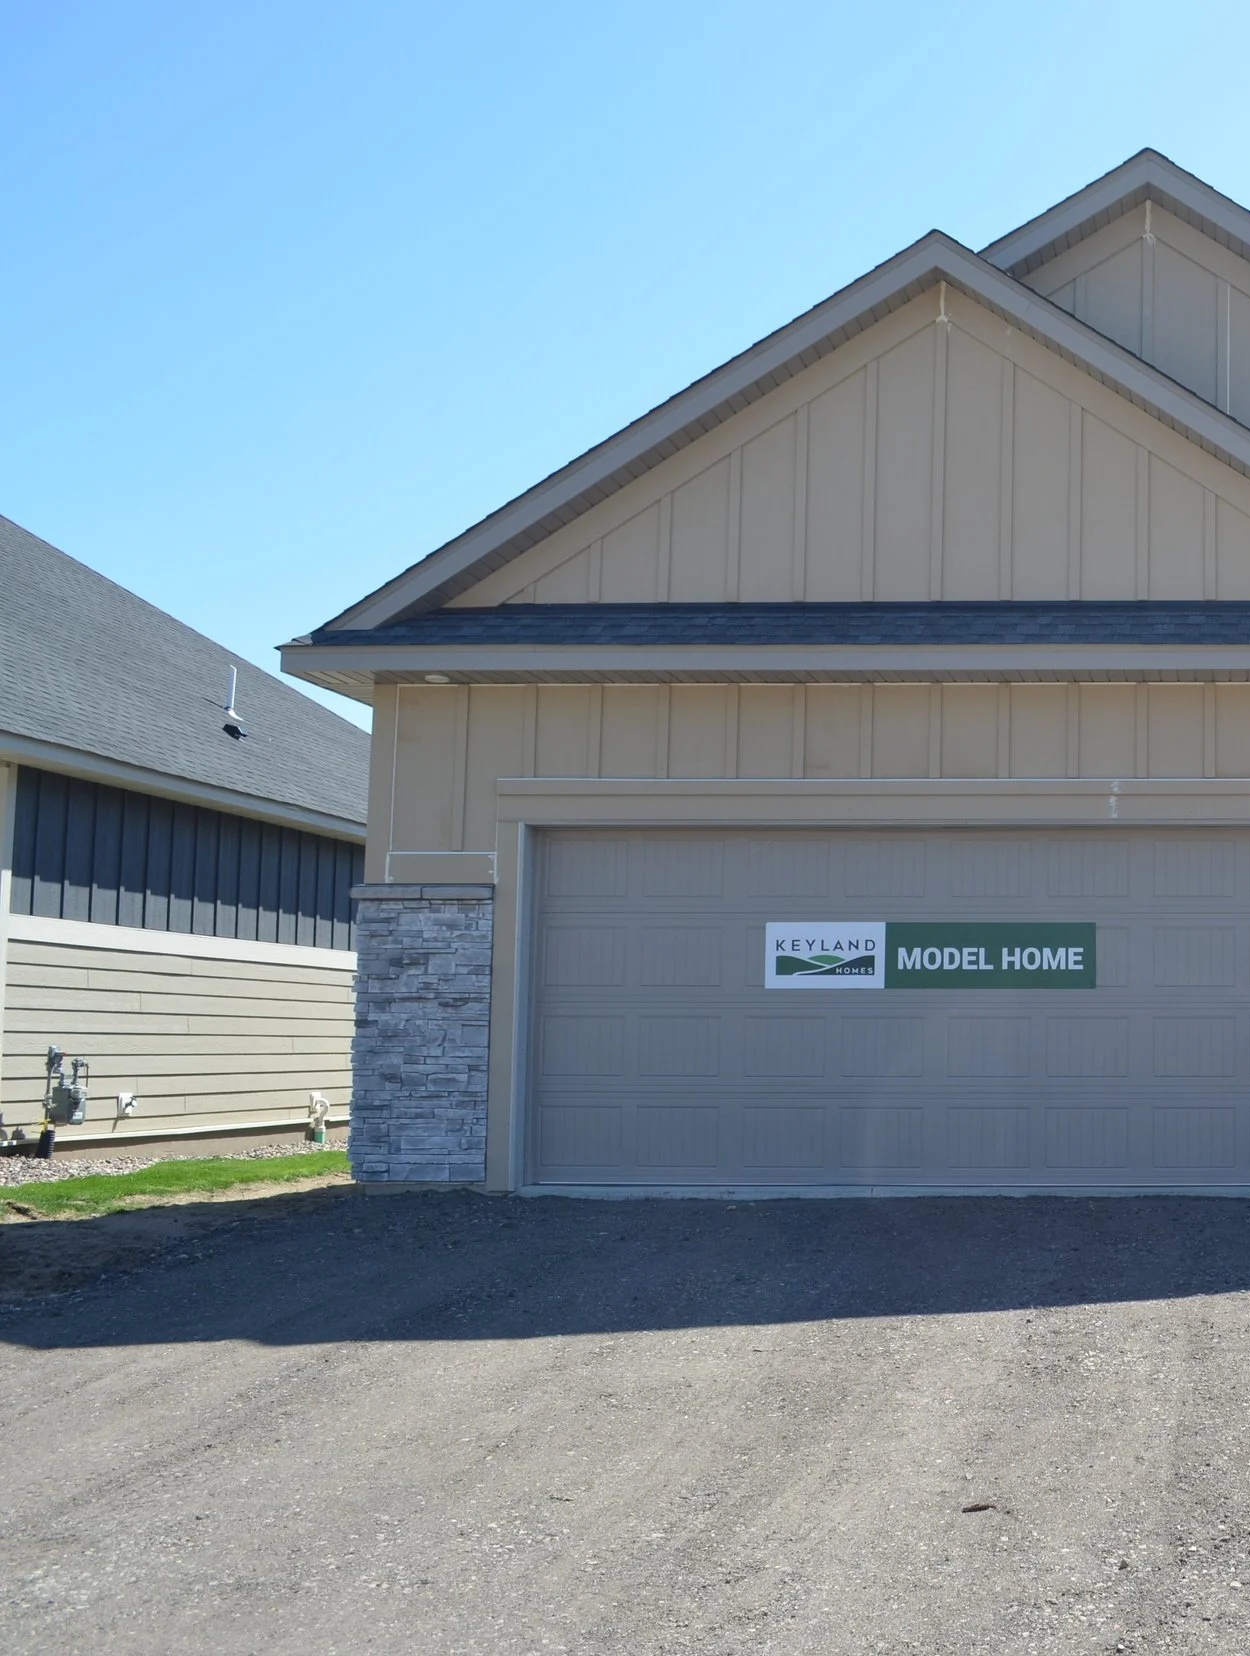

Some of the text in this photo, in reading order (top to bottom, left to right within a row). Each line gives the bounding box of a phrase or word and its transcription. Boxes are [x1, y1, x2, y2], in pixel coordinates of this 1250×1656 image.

[776, 939, 876, 952] KEYLAND
[897, 947, 1084, 970] MODEL HOME
[835, 967, 873, 975] HOMES
